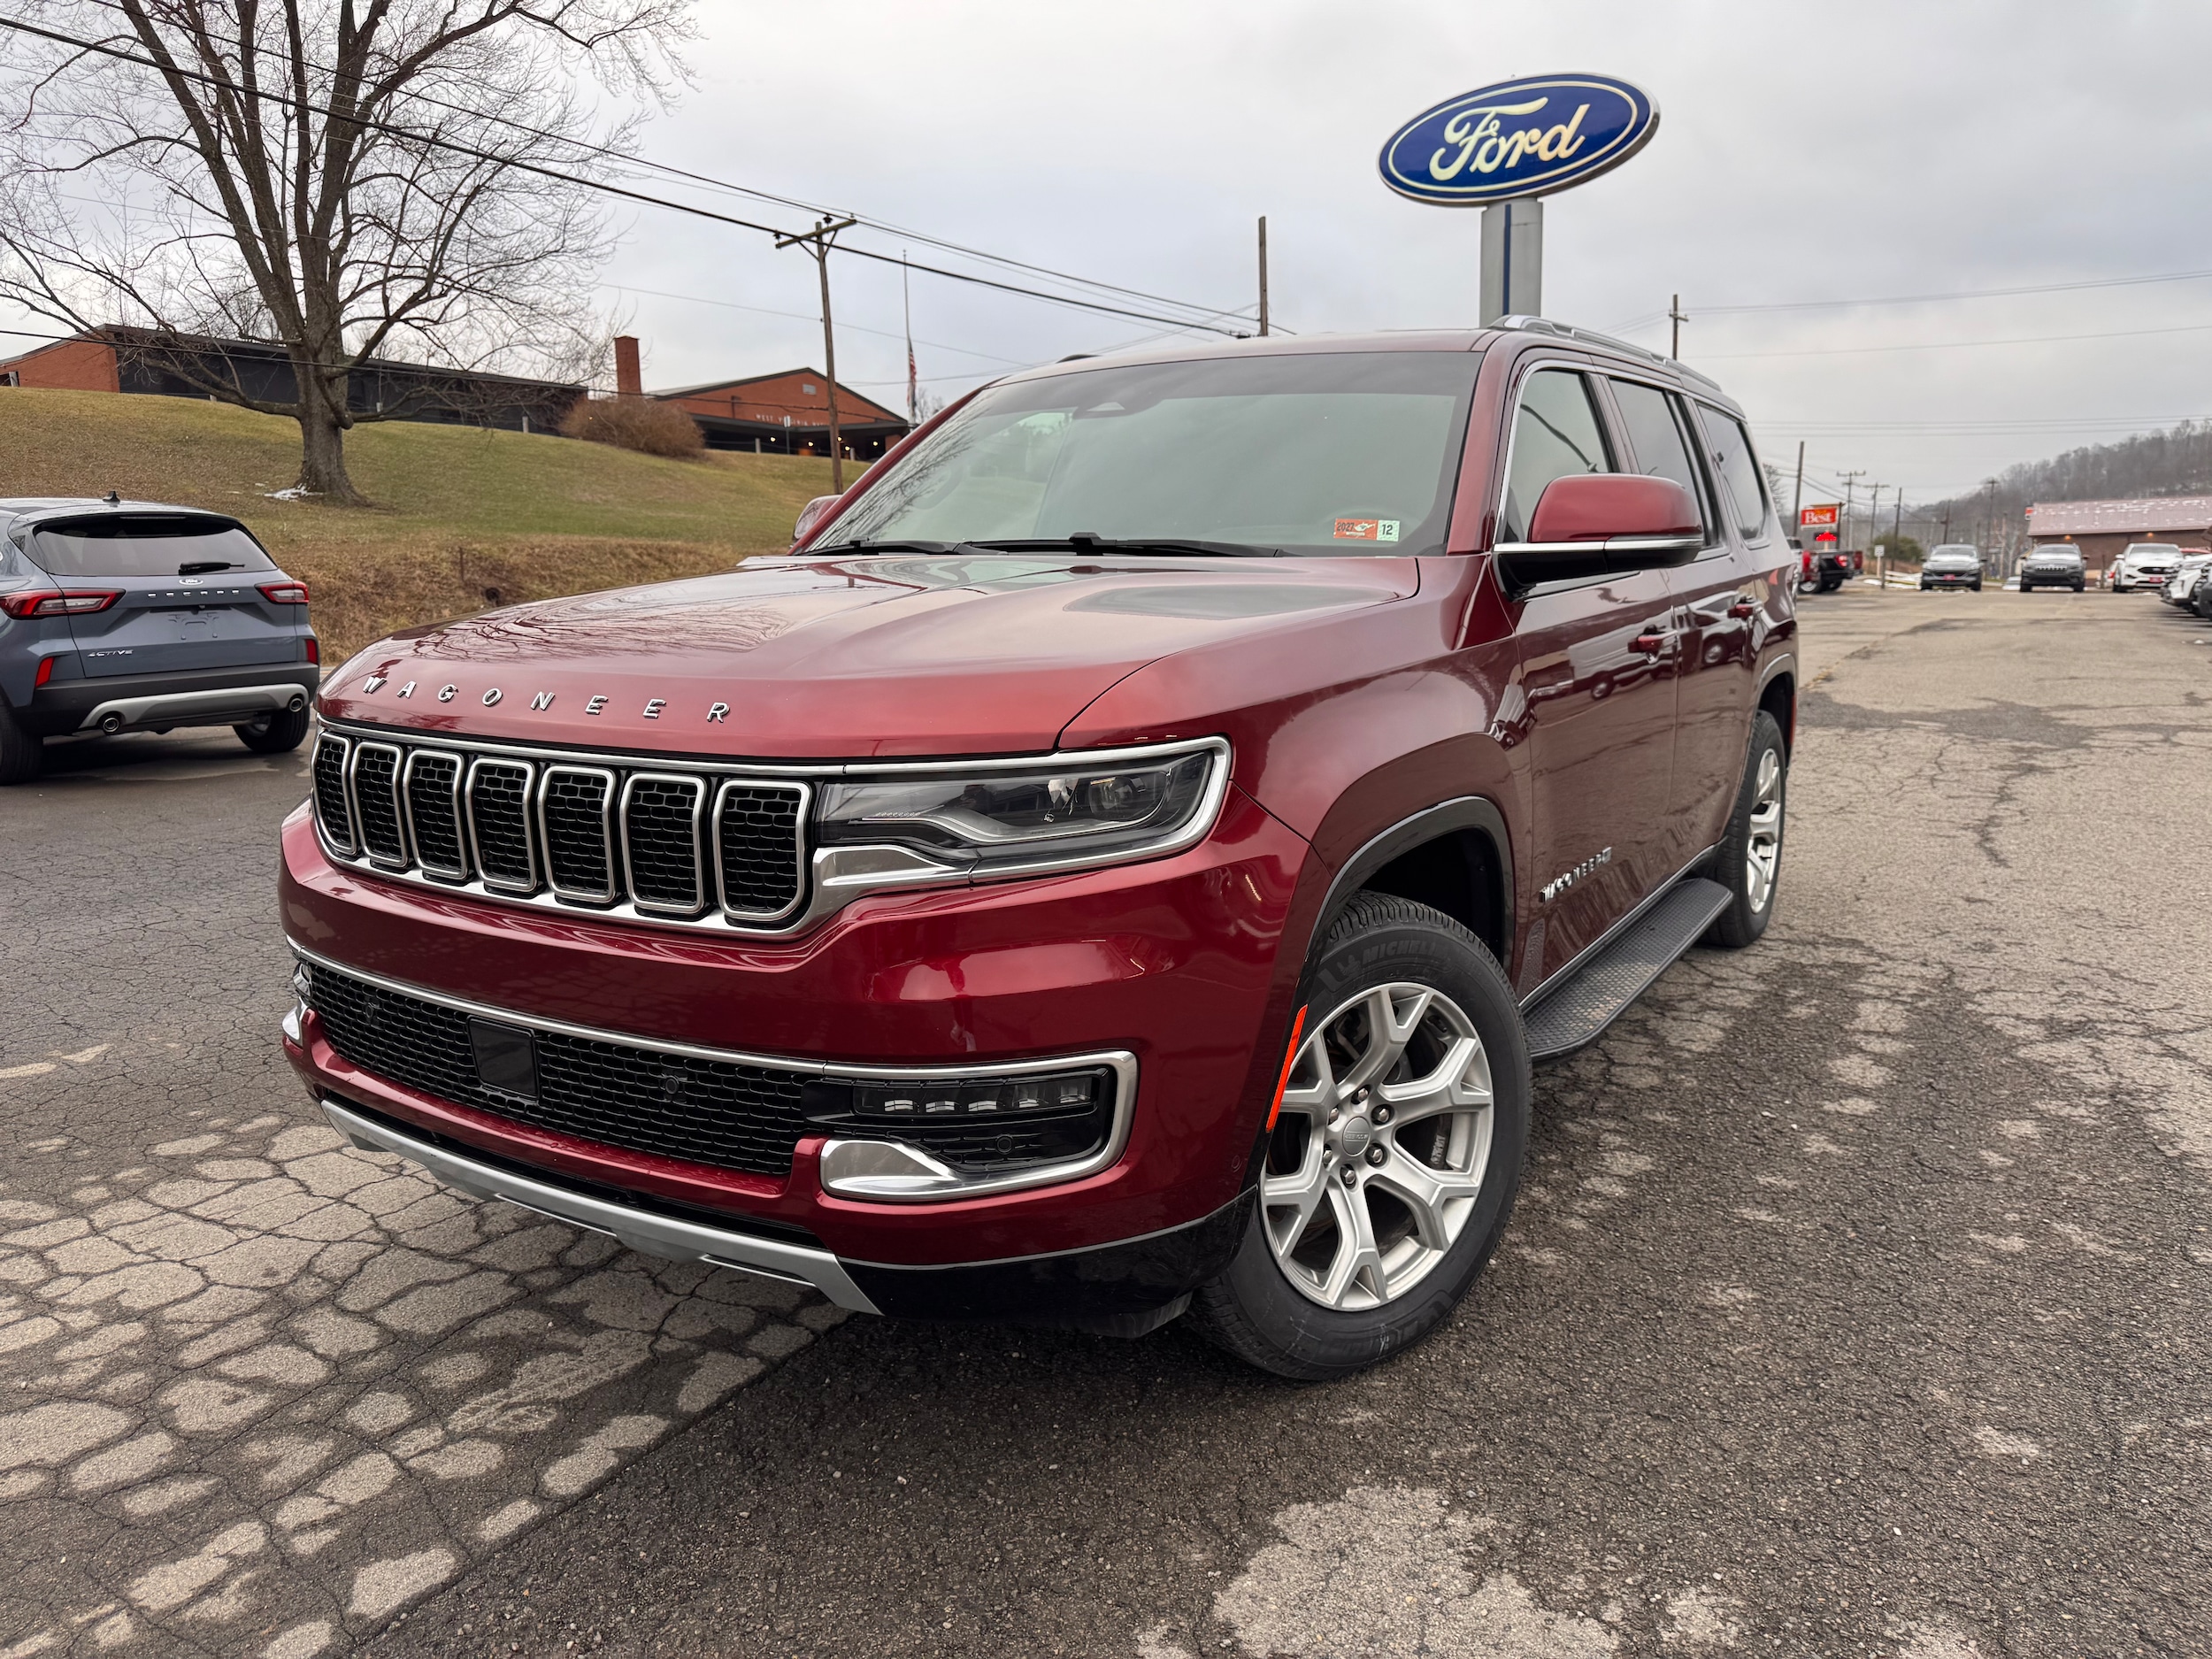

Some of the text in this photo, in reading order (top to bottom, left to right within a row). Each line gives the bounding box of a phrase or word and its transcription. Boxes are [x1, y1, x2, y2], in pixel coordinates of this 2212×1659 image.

[1429, 96, 1590, 180] Ford
[1805, 511, 1832, 524] Best
[1337, 522, 1355, 532] 2027
[1382, 524, 1394, 535] 12
[87, 649, 134, 657] ACTIVE
[363, 675, 731, 723] WAGONEER
